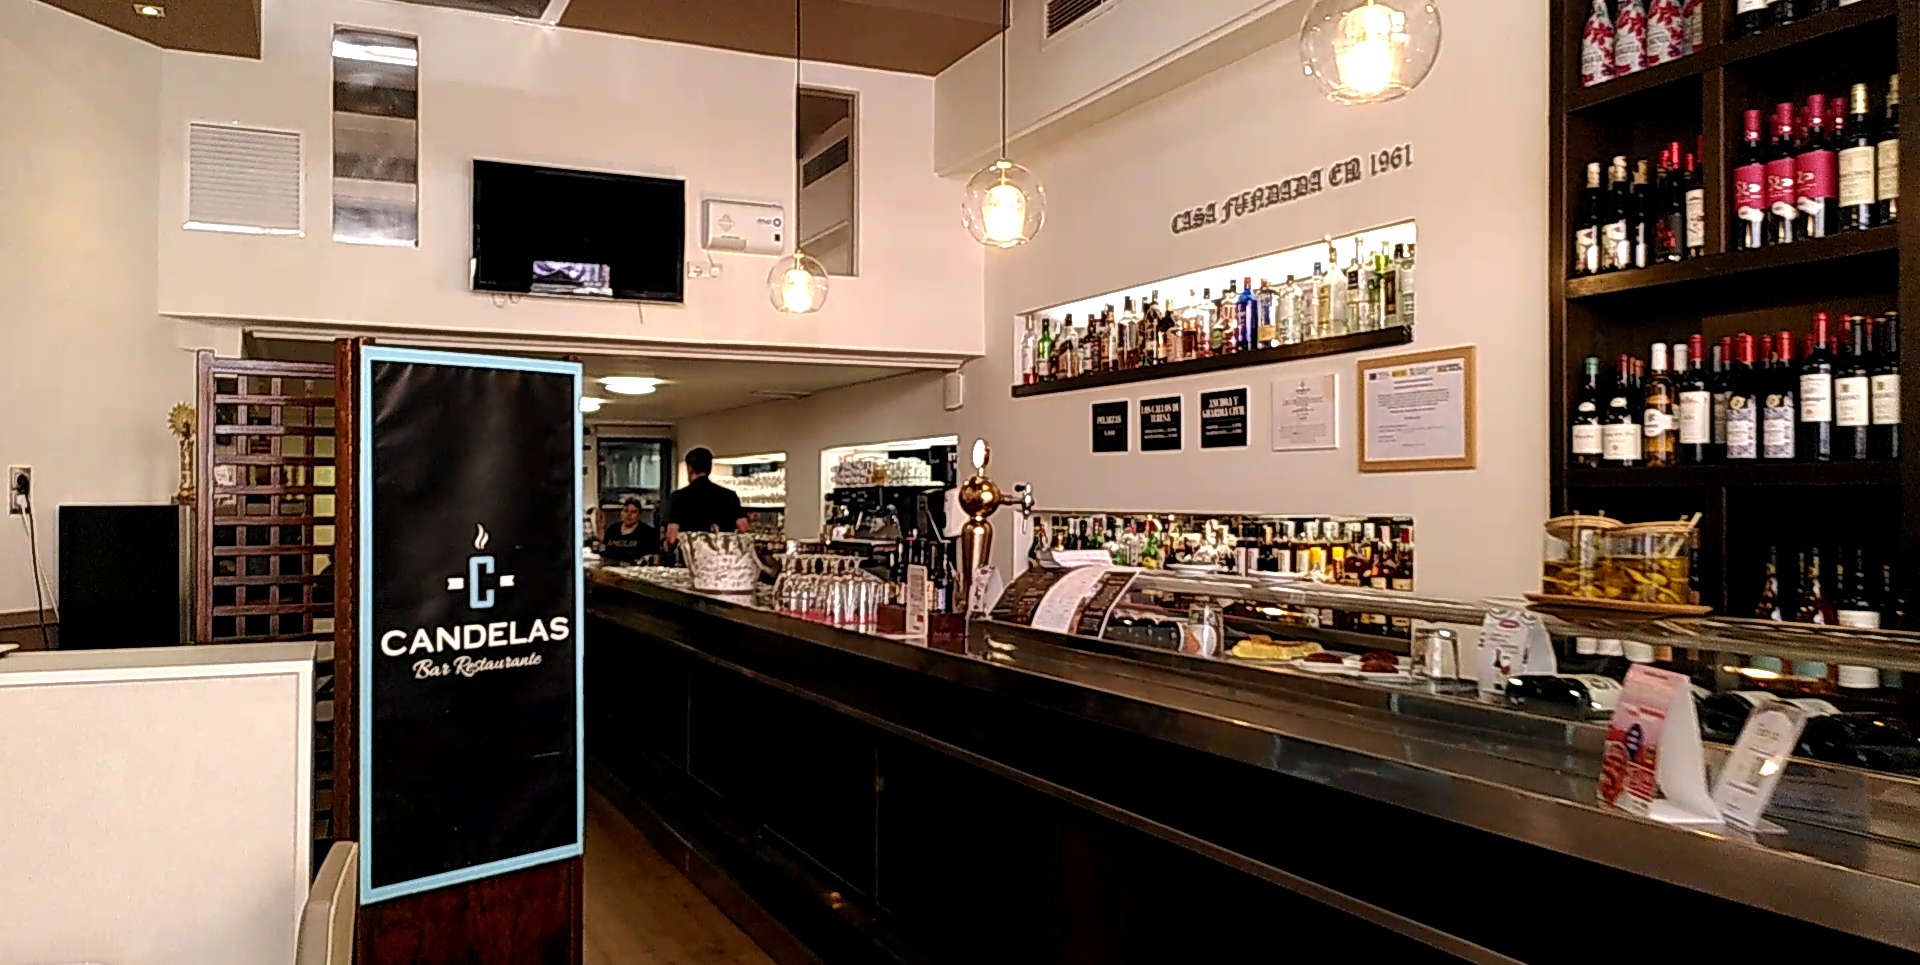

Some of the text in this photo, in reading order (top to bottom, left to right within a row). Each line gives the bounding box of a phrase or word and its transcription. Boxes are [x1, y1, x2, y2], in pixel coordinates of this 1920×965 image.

[1170, 202, 1218, 235] CASA
[1328, 156, 1362, 188] EN
[1370, 143, 1413, 177] 1961
[468, 555, 496, 610] C
[380, 616, 570, 657] CANDELAS
[412, 651, 543, 680] Bar Restaurante
